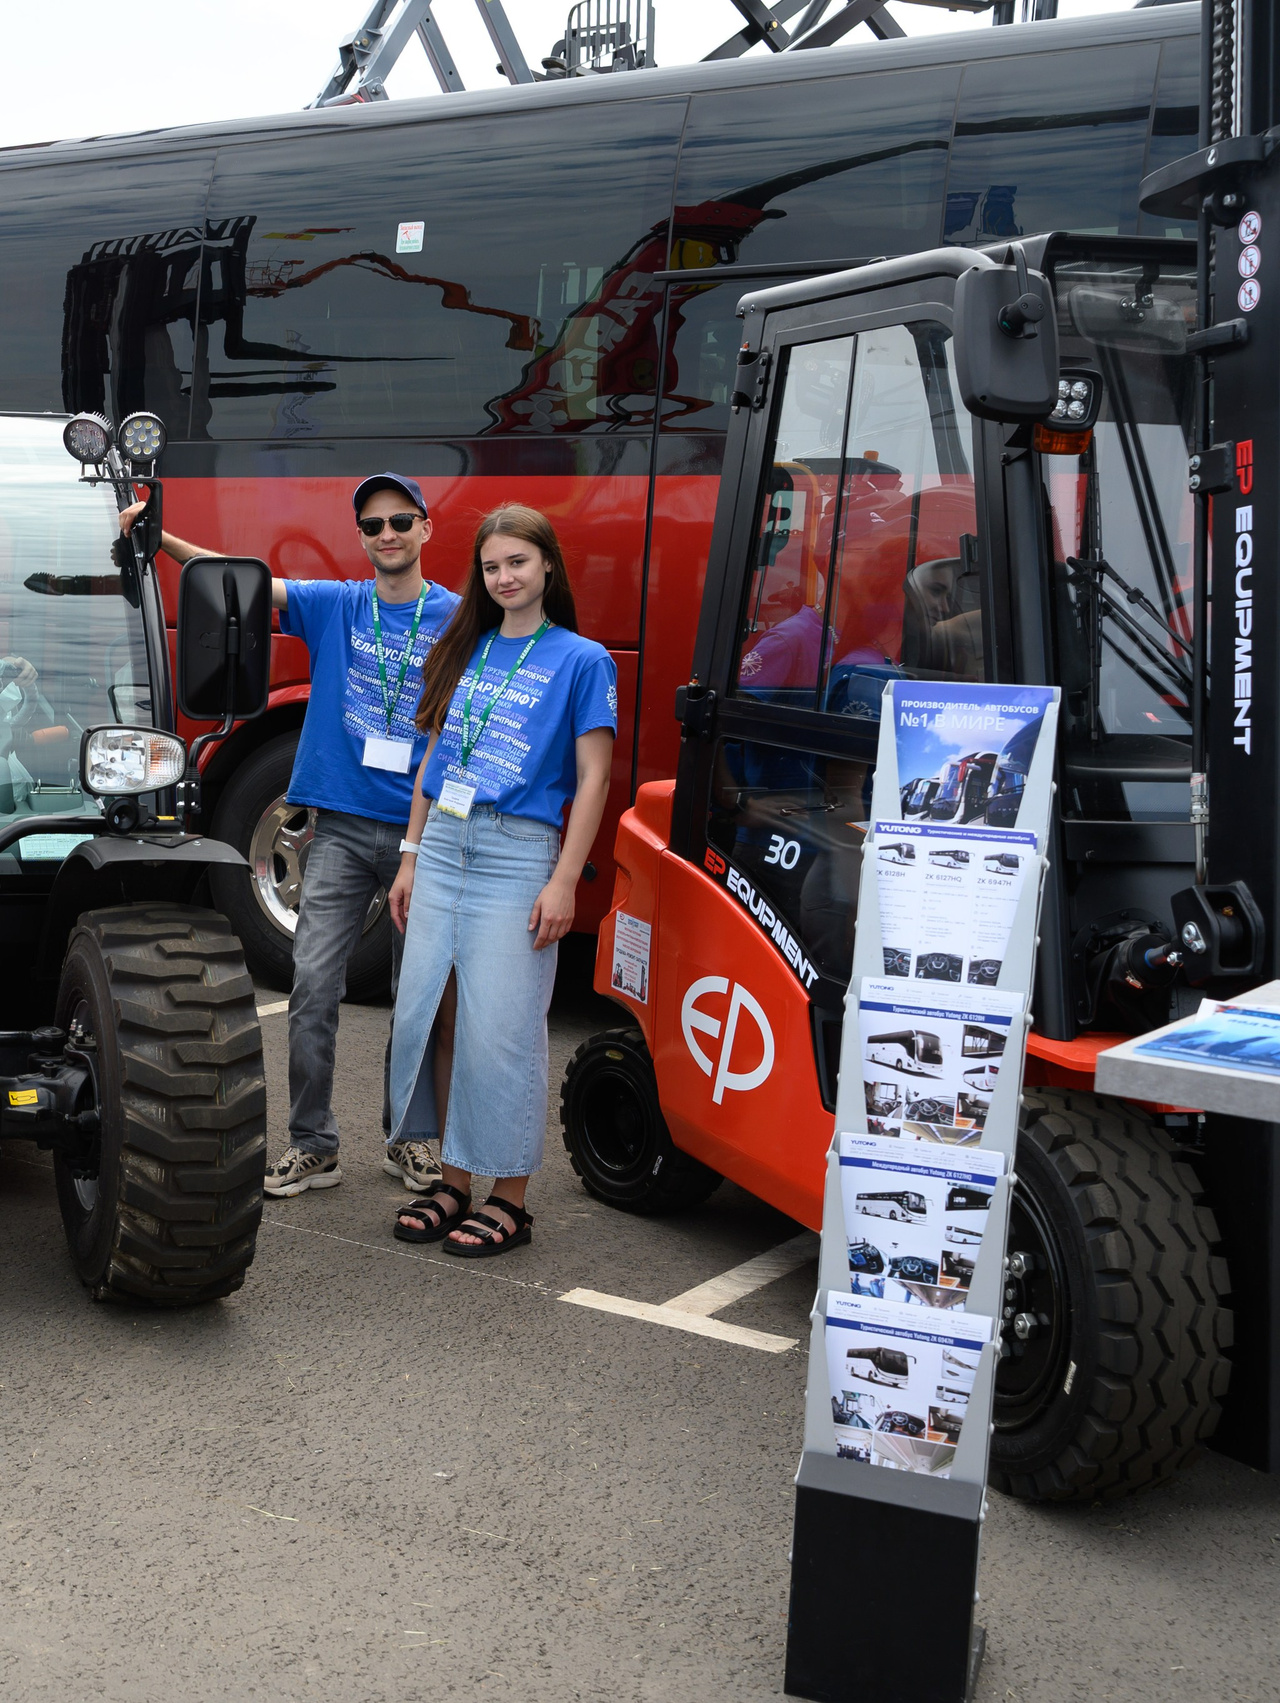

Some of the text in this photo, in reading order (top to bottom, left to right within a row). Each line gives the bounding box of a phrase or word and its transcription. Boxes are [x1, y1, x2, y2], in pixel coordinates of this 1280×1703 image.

[1236, 439, 1253, 495] EP
[1233, 505, 1253, 755] EQUIPMENT
[516, 668, 551, 684] АВТОБУСЫ
[526, 664, 556, 677] КРЕАТИВ
[901, 700, 1039, 714] ПРОИЗВОДИТЕЛЬ АВТОБУСОВ
[900, 712, 1006, 732] №1 В МИРЕ
[879, 824, 921, 834] YUTONG
[764, 834, 801, 870] 30
[936, 874, 962, 883] 6127HQ
[704, 847, 819, 989] EP EQUIPMENT
[851, 1139, 877, 1147] YUTONG
[836, 1300, 861, 1309] YUTONG
